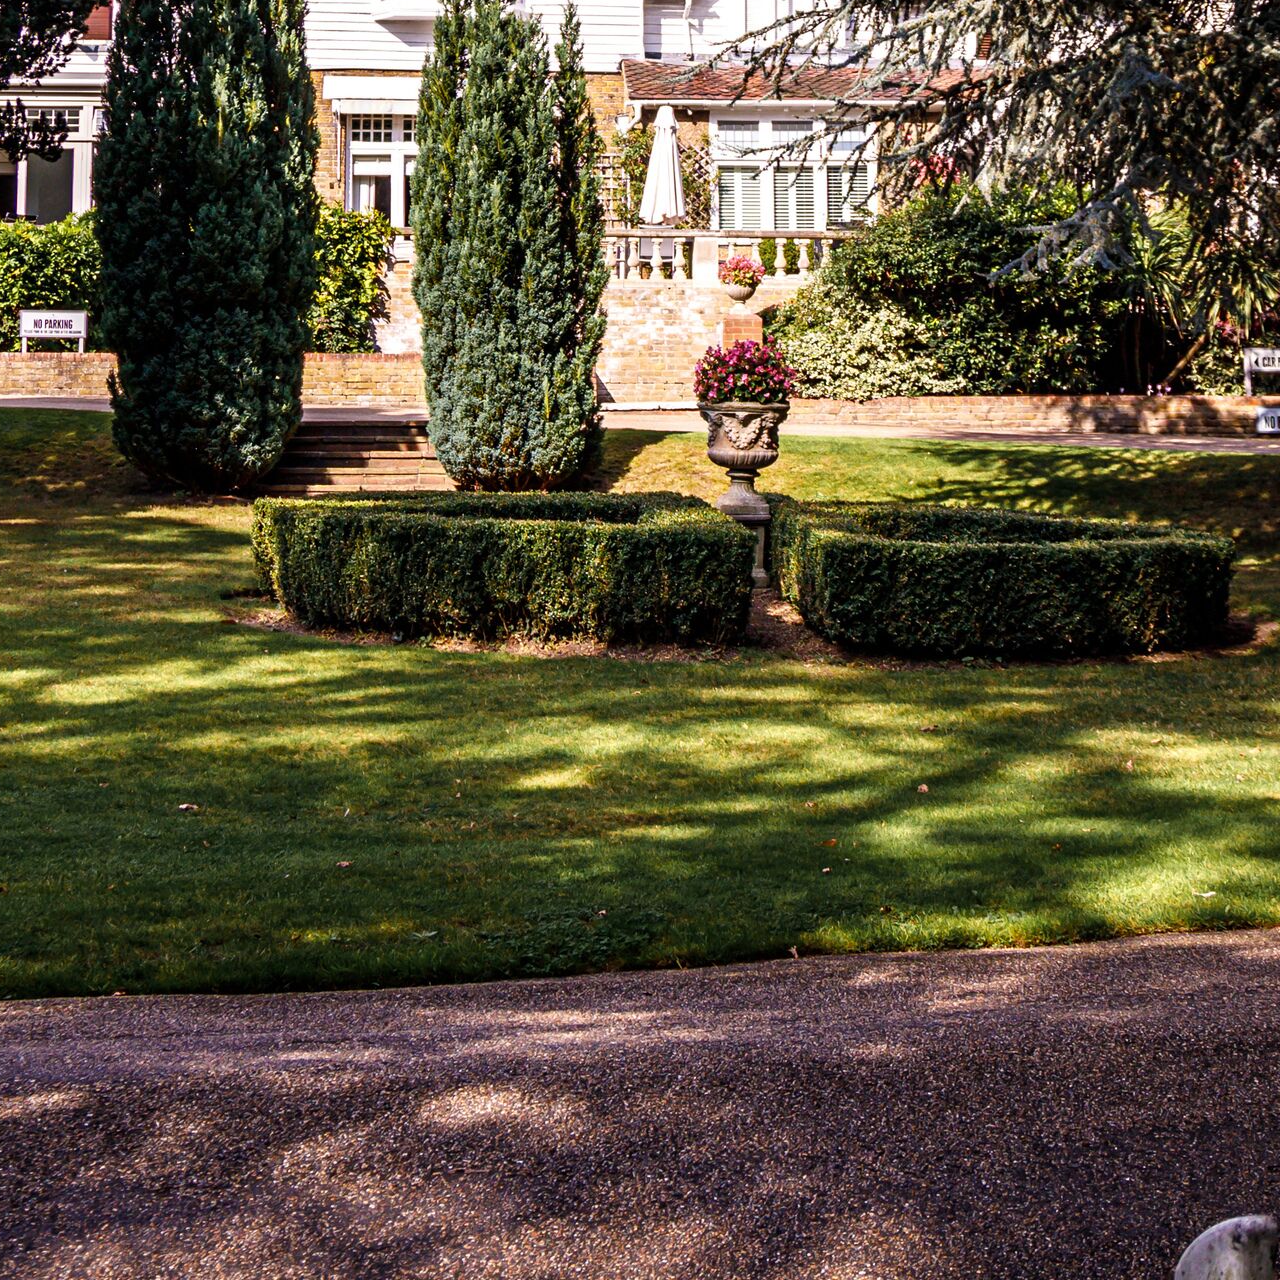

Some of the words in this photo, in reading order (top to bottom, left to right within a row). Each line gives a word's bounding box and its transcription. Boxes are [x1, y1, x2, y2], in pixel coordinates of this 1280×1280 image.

[33, 319, 42, 329] NO
[44, 319, 73, 329] PARKING
[1262, 357, 1276, 367] CAR
[1264, 416, 1275, 429] NO
